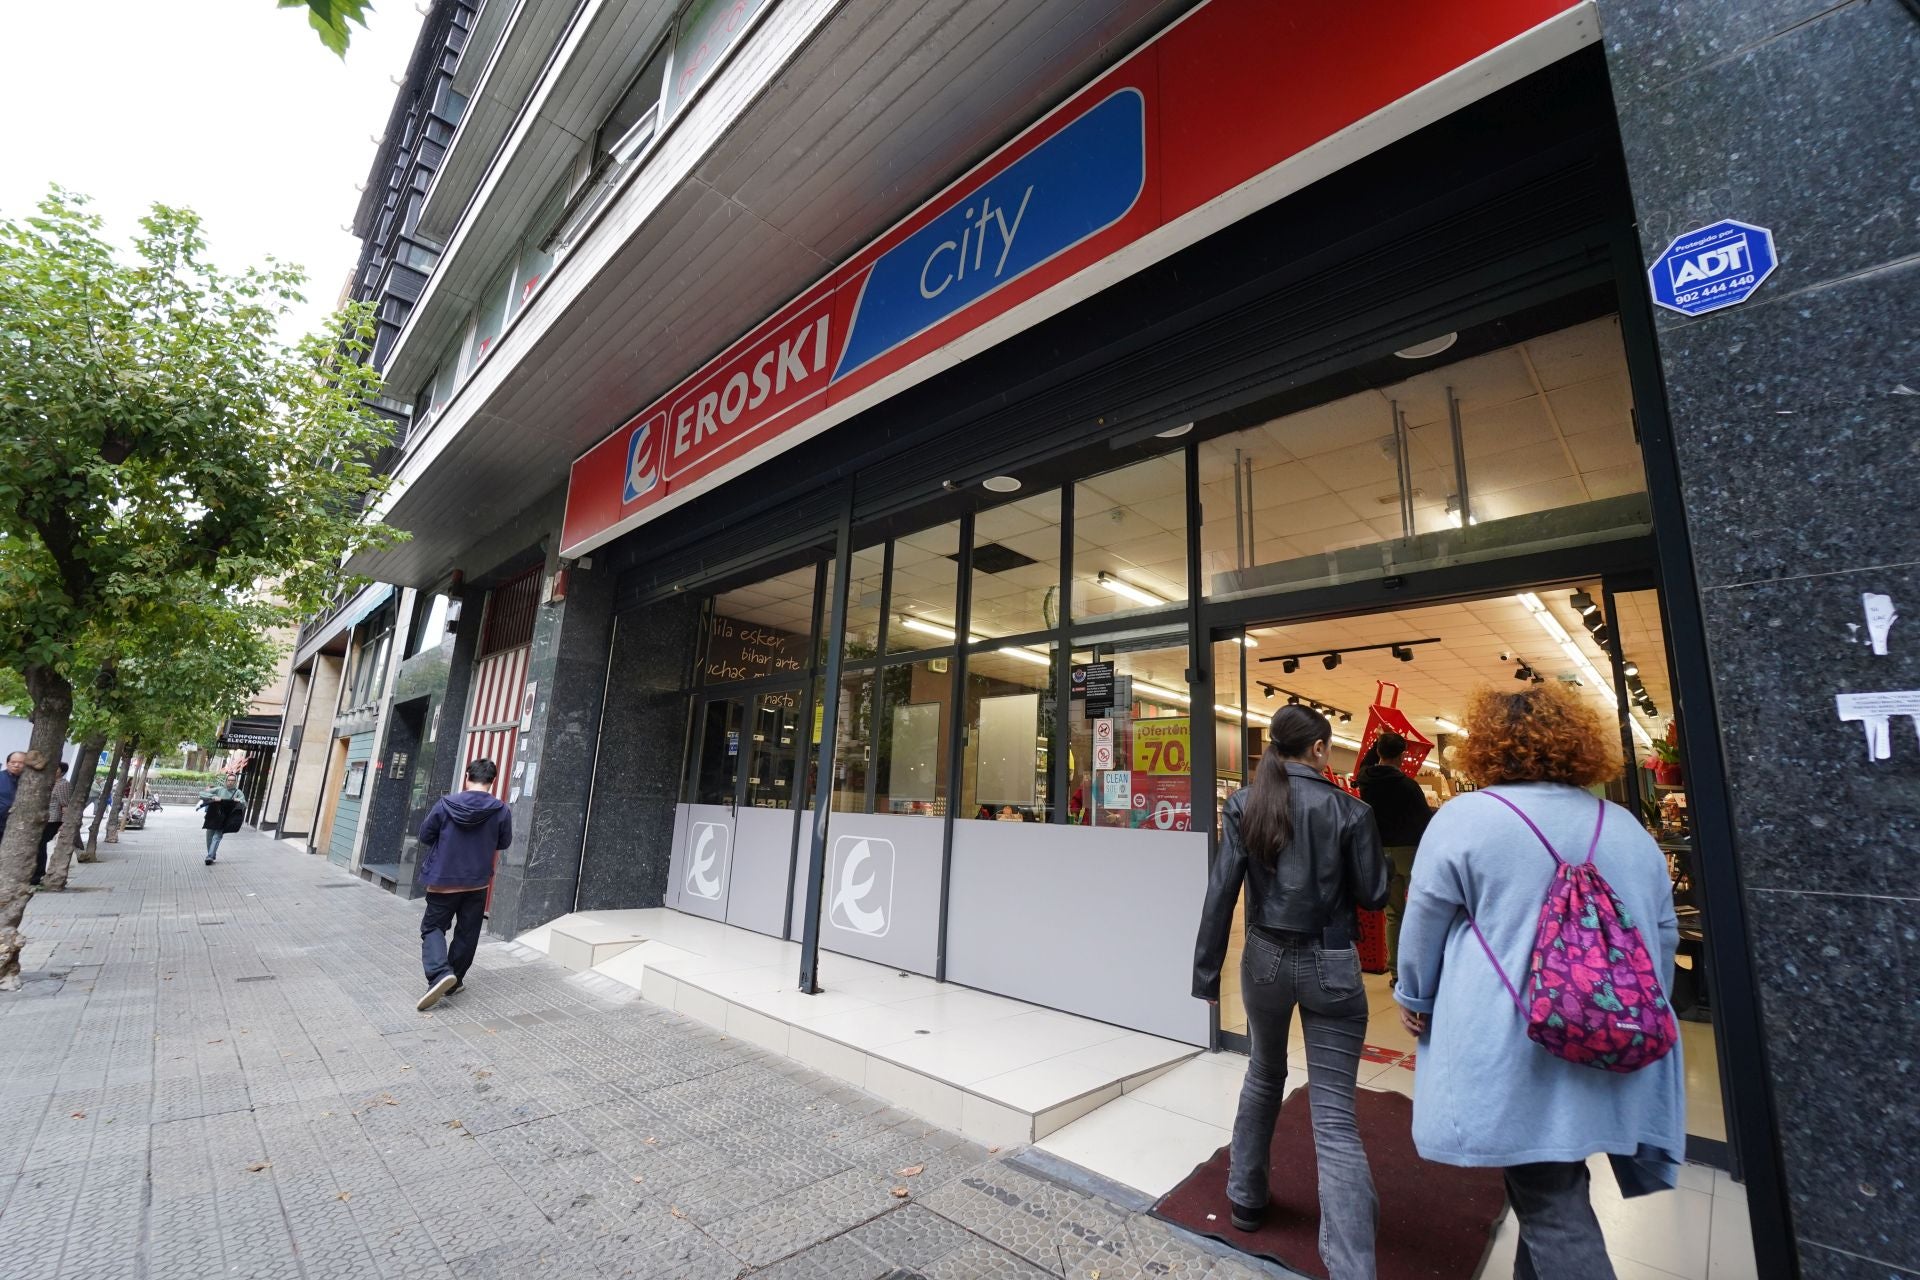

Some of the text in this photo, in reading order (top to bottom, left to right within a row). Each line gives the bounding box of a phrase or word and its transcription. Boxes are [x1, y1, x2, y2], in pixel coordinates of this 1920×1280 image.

[1675, 229, 1734, 252] Protegido por
[1674, 241, 1746, 288] ADT
[1675, 291, 1699, 305] 902
[1701, 283, 1727, 296] 444
[1729, 274, 1755, 288] 440
[673, 185, 1034, 458] EROSKI city
[740, 629, 785, 654] esker,
[741, 647, 800, 671] bihar arte
[227, 738, 278, 746] ELECTRONICOS
[228, 733, 278, 742] COMPONENTES
[1105, 773, 1129, 784] CLEAN
